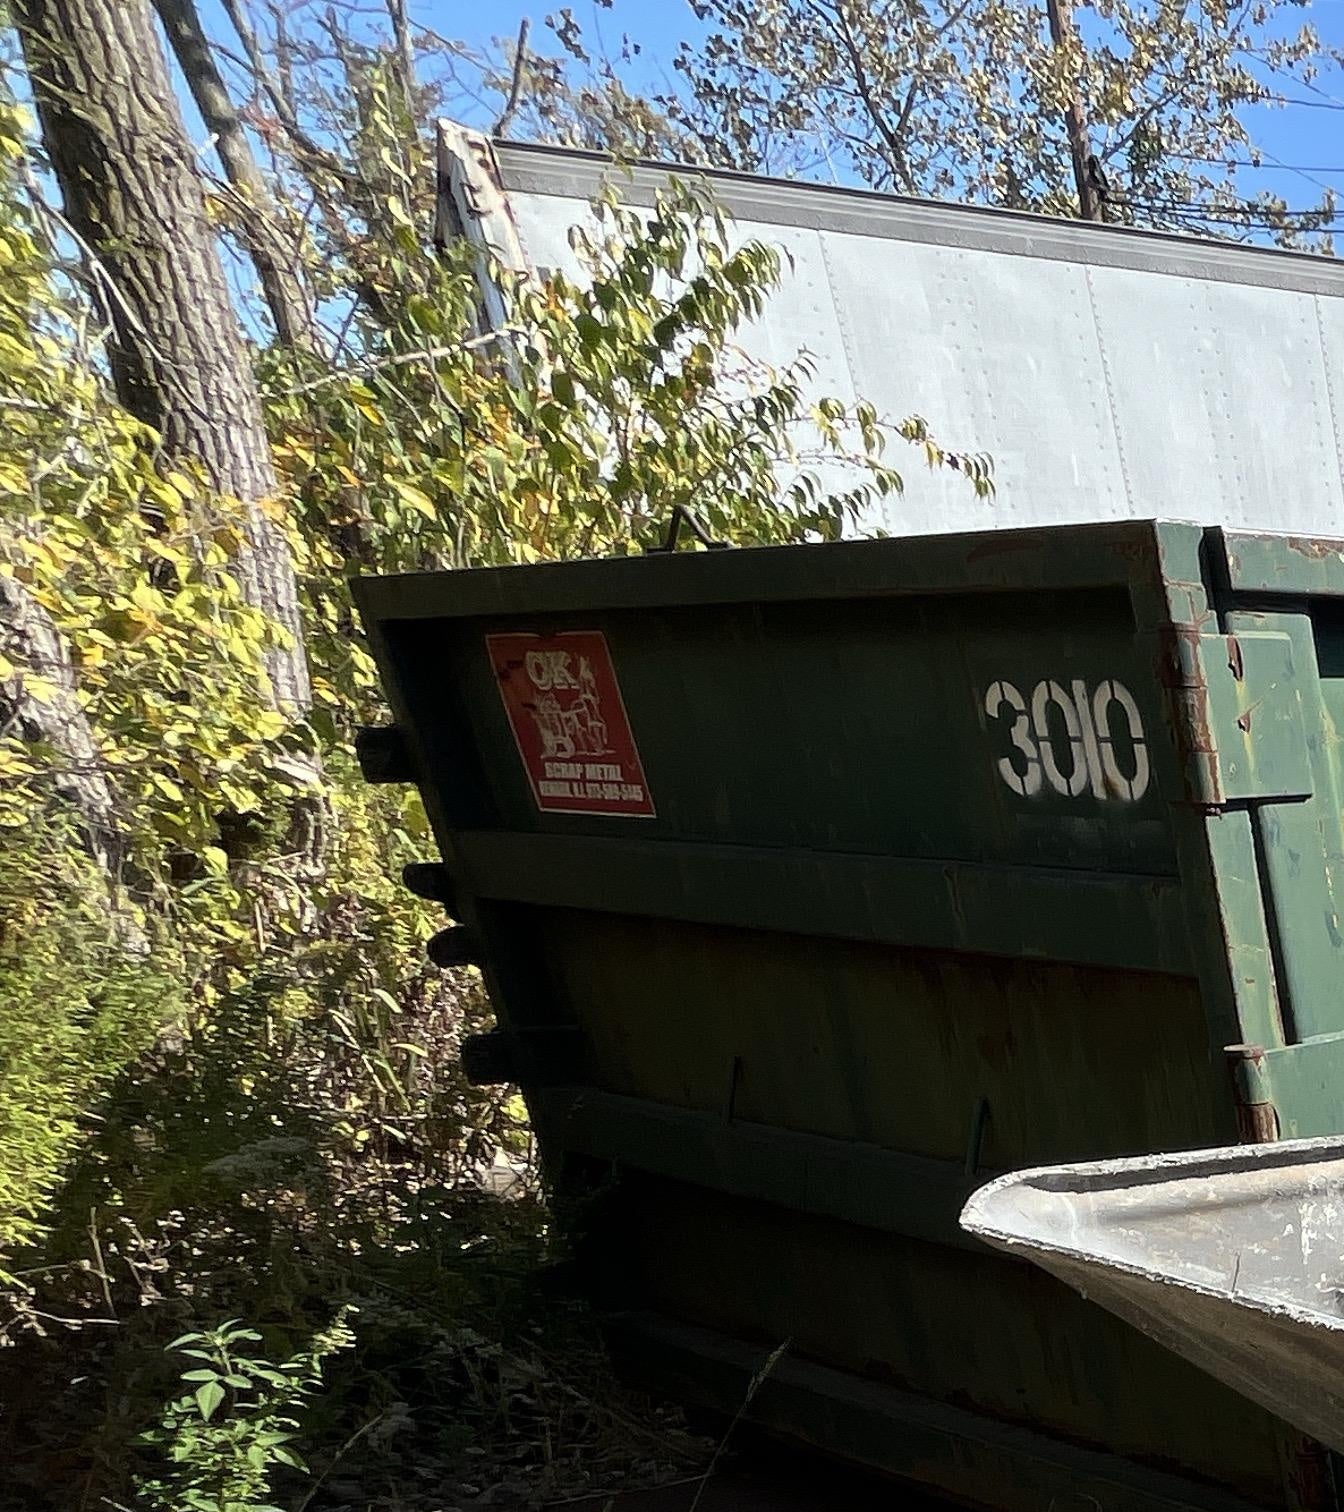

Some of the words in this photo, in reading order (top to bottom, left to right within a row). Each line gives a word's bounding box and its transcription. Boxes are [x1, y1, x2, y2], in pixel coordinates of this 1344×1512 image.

[526, 651, 580, 690] OK
[985, 679, 1150, 801] 3010
[586, 763, 624, 781] METAL
